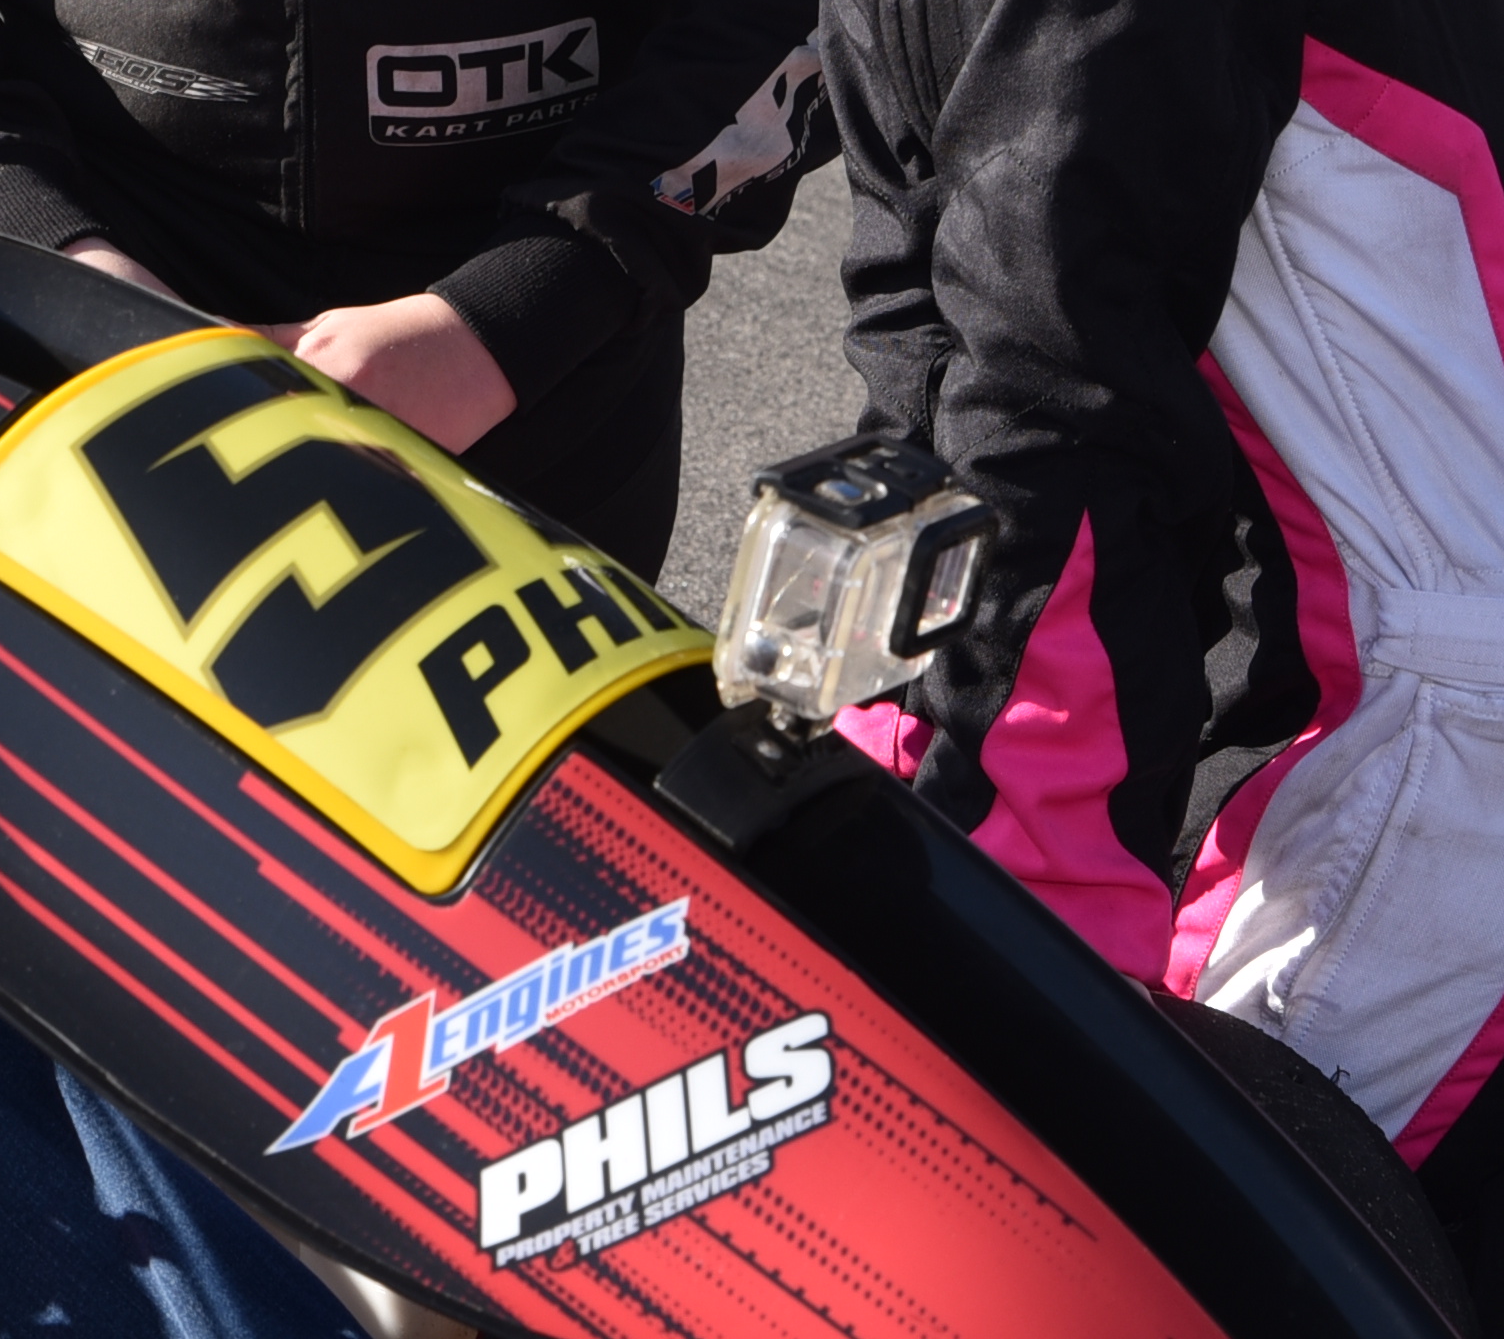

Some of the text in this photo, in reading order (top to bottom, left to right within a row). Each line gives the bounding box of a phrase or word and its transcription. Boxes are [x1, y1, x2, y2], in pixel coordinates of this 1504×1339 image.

[377, 26, 595, 107] OTK
[385, 119, 491, 139] KART
[417, 556, 682, 771] PHI
[544, 944, 686, 1023] MOTORSPORT
[479, 1012, 832, 1249] PHILS
[494, 1100, 829, 1269] PROPERTY MAINTENANCE
[578, 1210, 640, 1256] TREE
[642, 1149, 771, 1228] SERVICES
